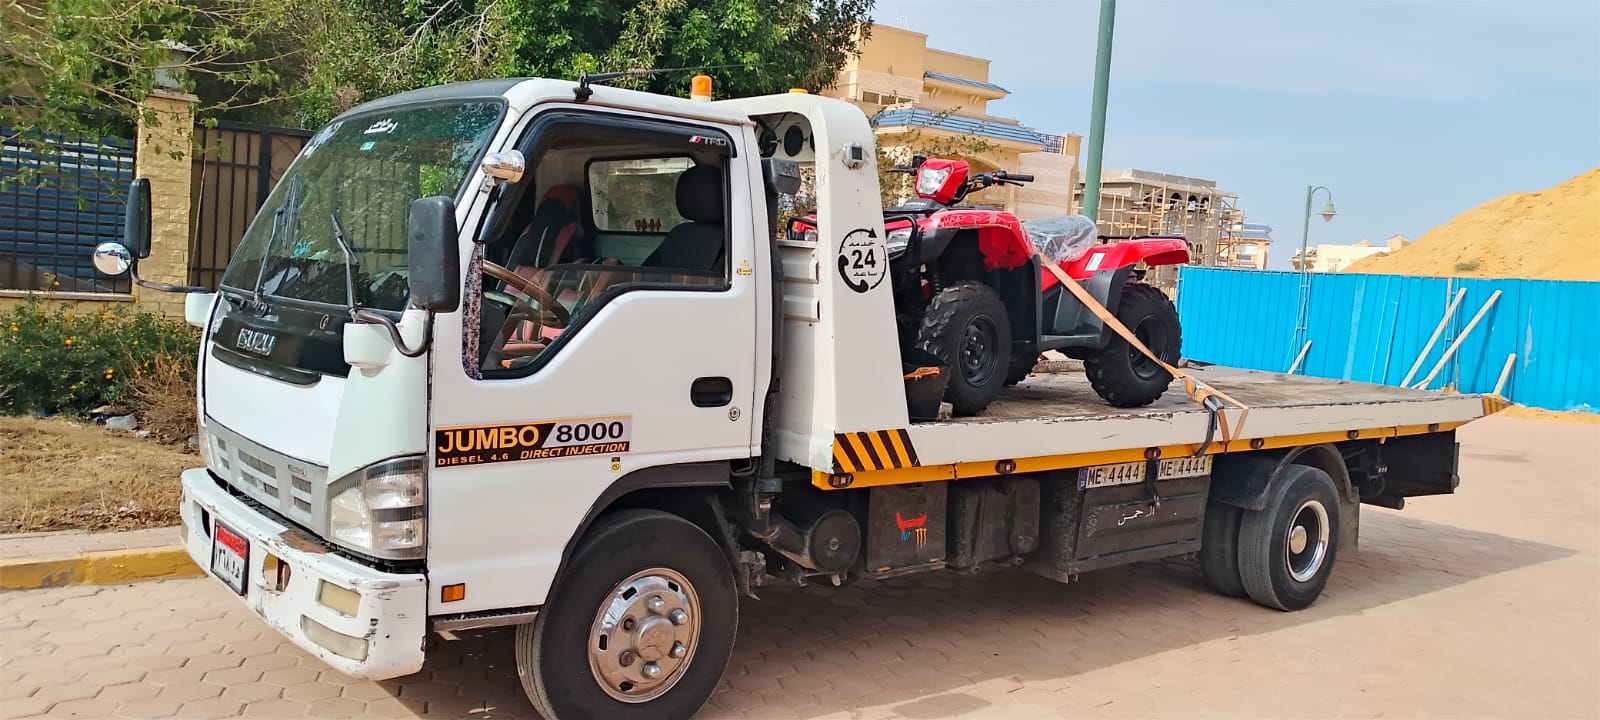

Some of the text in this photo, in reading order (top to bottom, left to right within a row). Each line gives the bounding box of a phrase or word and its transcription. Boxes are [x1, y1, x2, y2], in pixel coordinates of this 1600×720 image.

[852, 249, 876, 269] 24
[236, 327, 276, 356] ISUZU
[438, 421, 624, 453] JUMBO 8000
[438, 442, 627, 465] DIESEL 4.6 DIRECT INJECTION
[1088, 468, 1103, 486] ME
[1109, 464, 1140, 482] 4444
[1160, 459, 1206, 477] ME 4444
